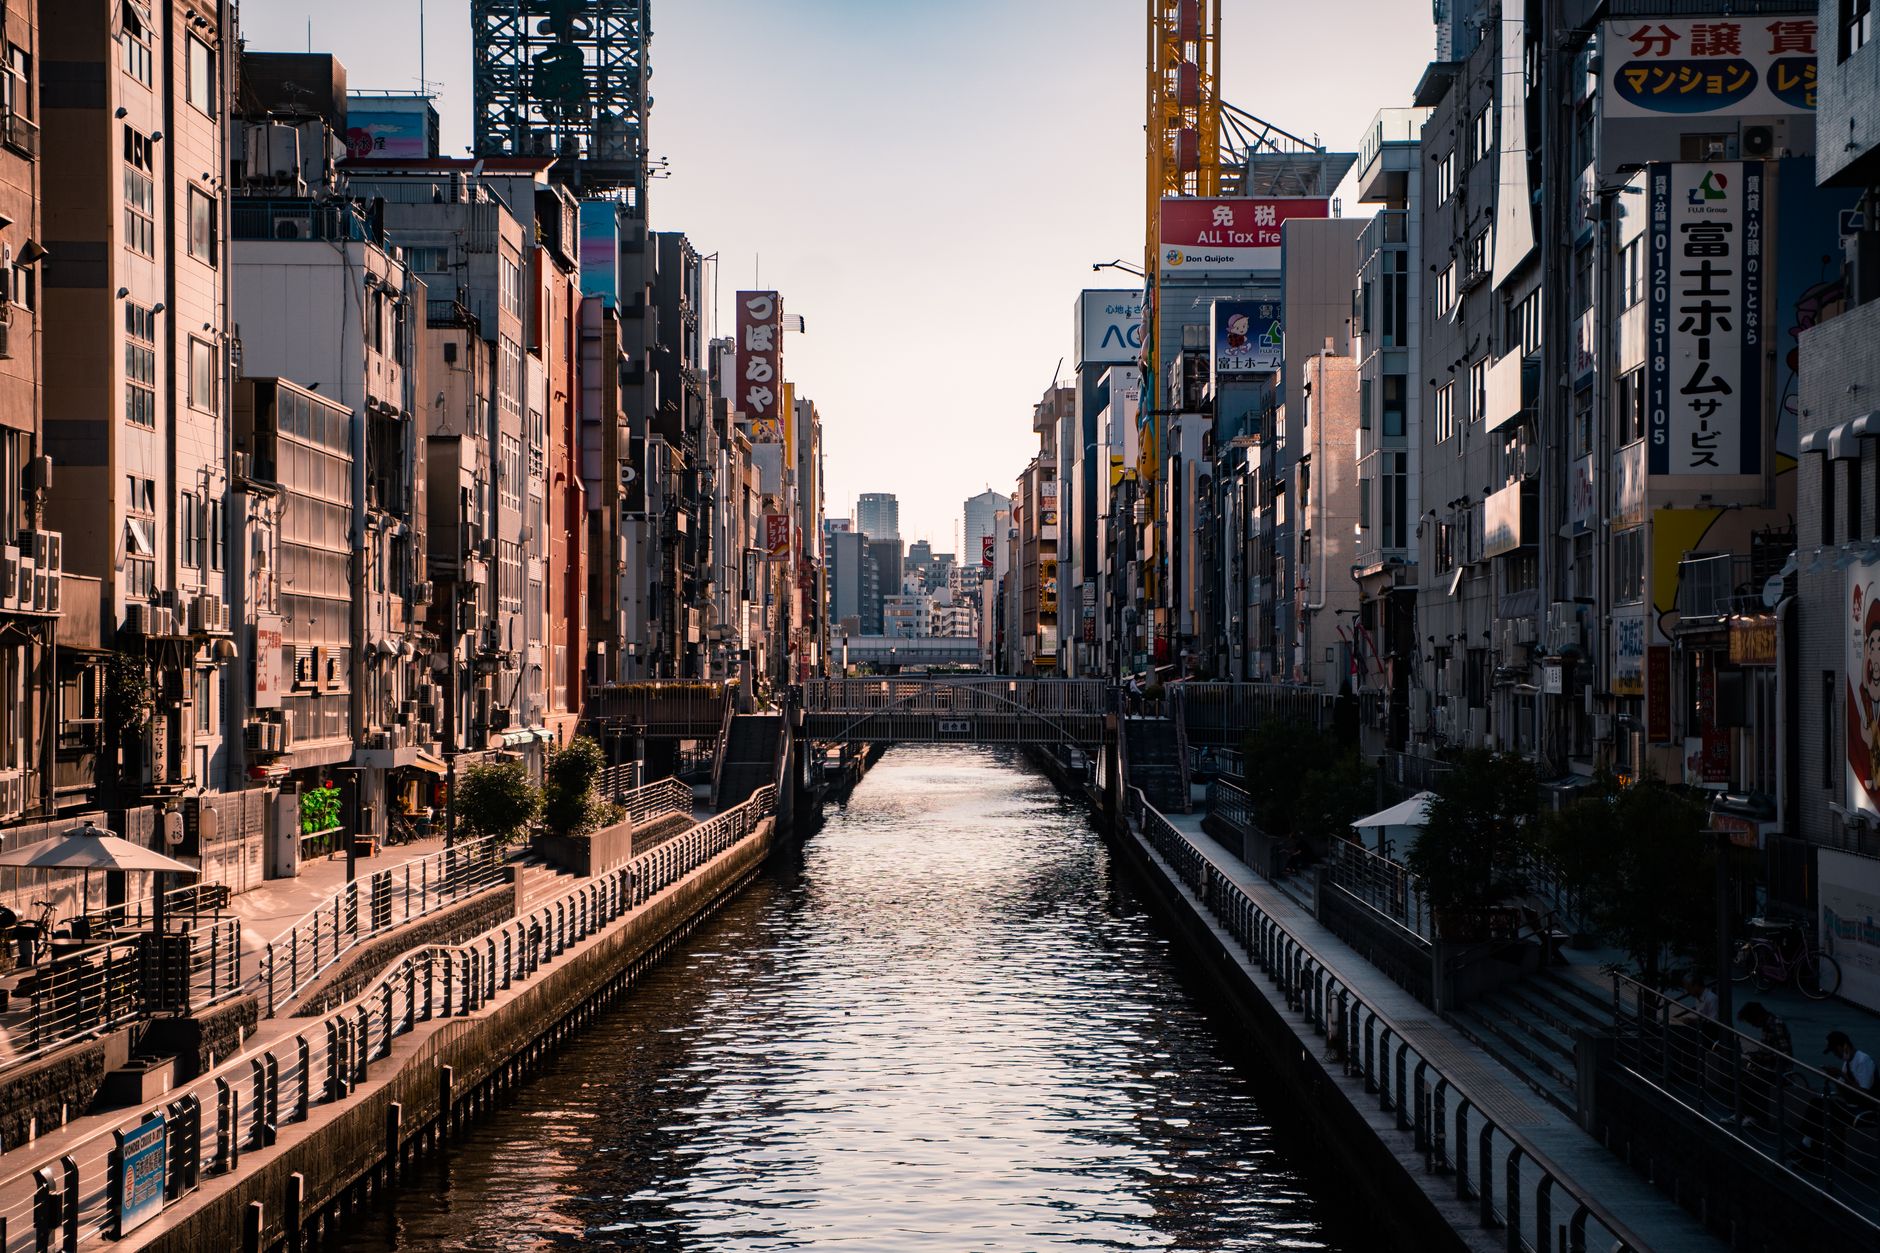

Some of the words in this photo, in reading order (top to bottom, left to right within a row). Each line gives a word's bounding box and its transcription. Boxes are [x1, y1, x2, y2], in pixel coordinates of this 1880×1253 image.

[1628, 22, 1742, 57] 分譲
[1623, 64, 1751, 95] マンション
[1212, 205, 1277, 227] 免税
[1197, 230, 1223, 243] ALL
[1227, 230, 1254, 243] Tax
[1258, 230, 1280, 243] Fre
[1204, 255, 1234, 263] Quijote
[1678, 220, 1733, 467] 富士ホームサービス
[1218, 357, 1281, 370] 富士ホーム
[777, 516, 788, 544] ツルハ
